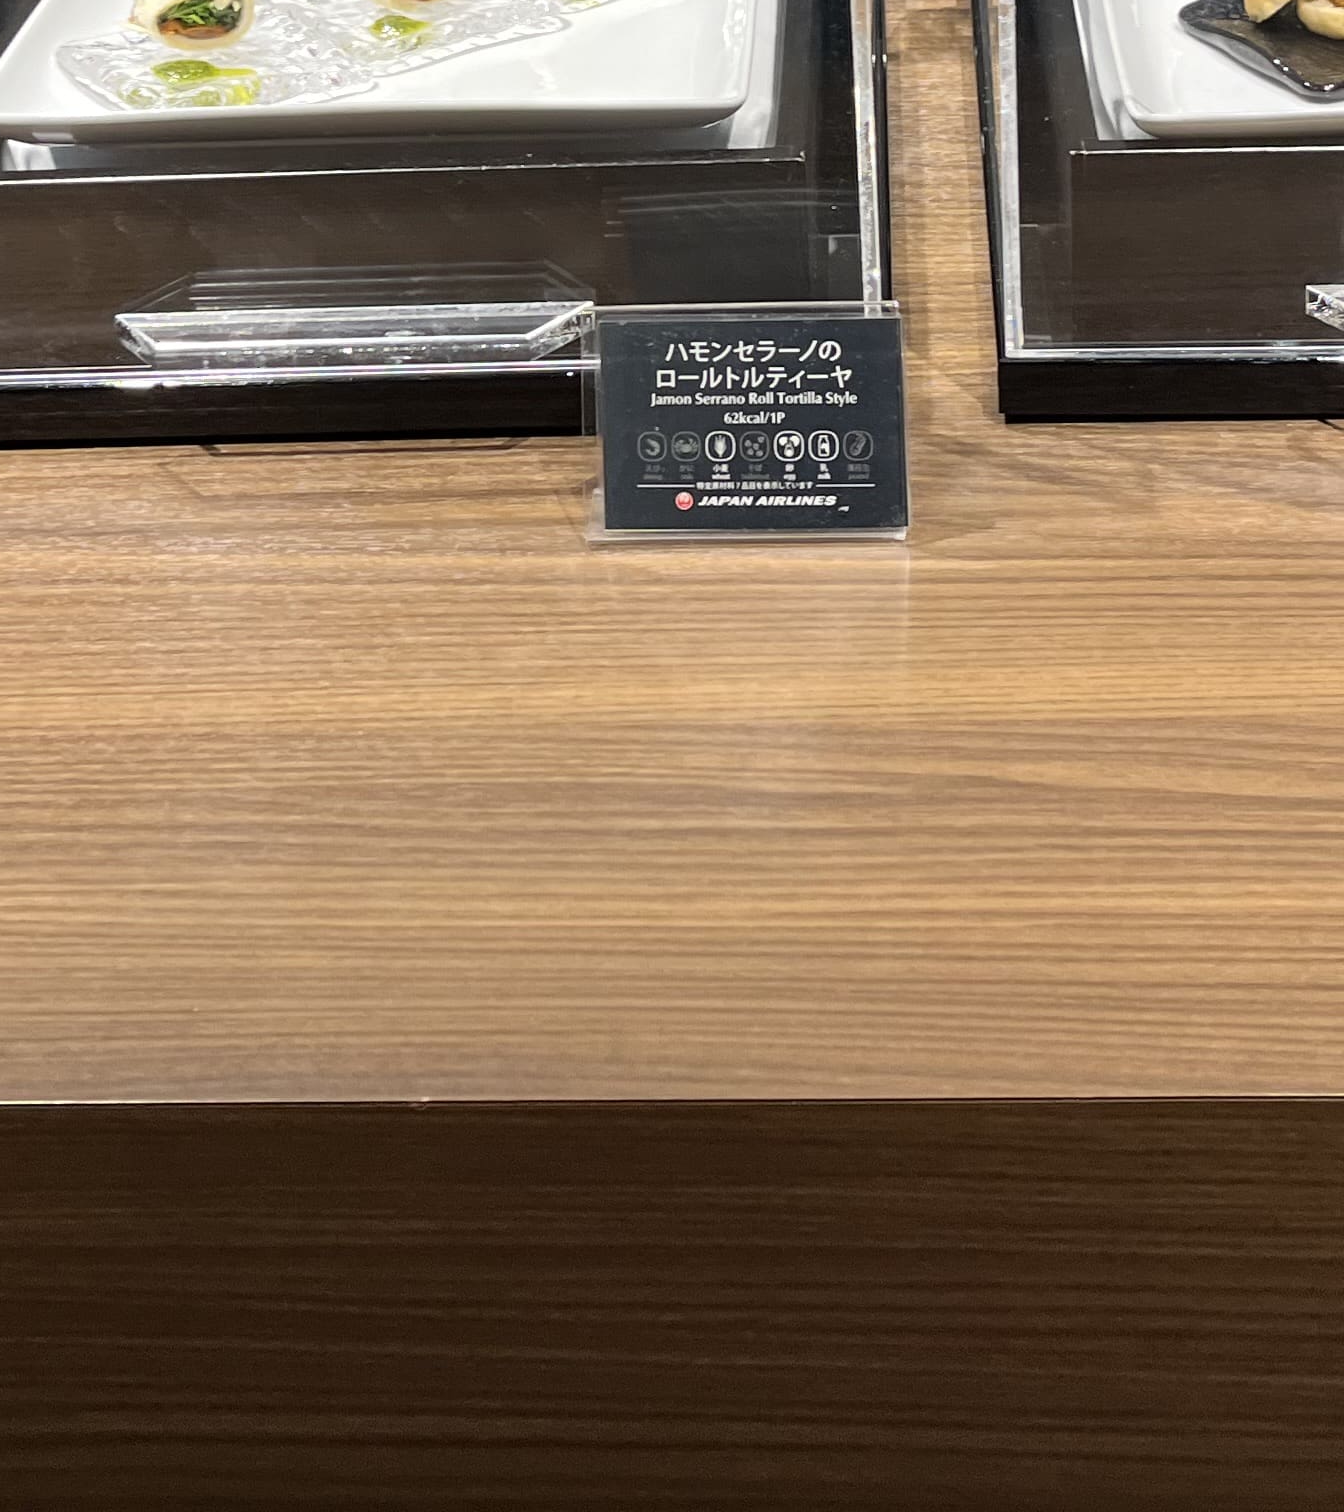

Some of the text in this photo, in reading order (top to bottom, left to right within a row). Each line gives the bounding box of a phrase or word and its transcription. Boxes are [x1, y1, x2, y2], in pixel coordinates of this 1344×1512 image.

[665, 340, 842, 362] ハモンセラーノの
[656, 365, 853, 389] ロールトルティーヤ
[650, 391, 858, 407] Jamon Serrano Roll Tortilla Style
[723, 411, 786, 424] 62kcal/1P
[697, 495, 837, 506] JAPAN AIRLINES
